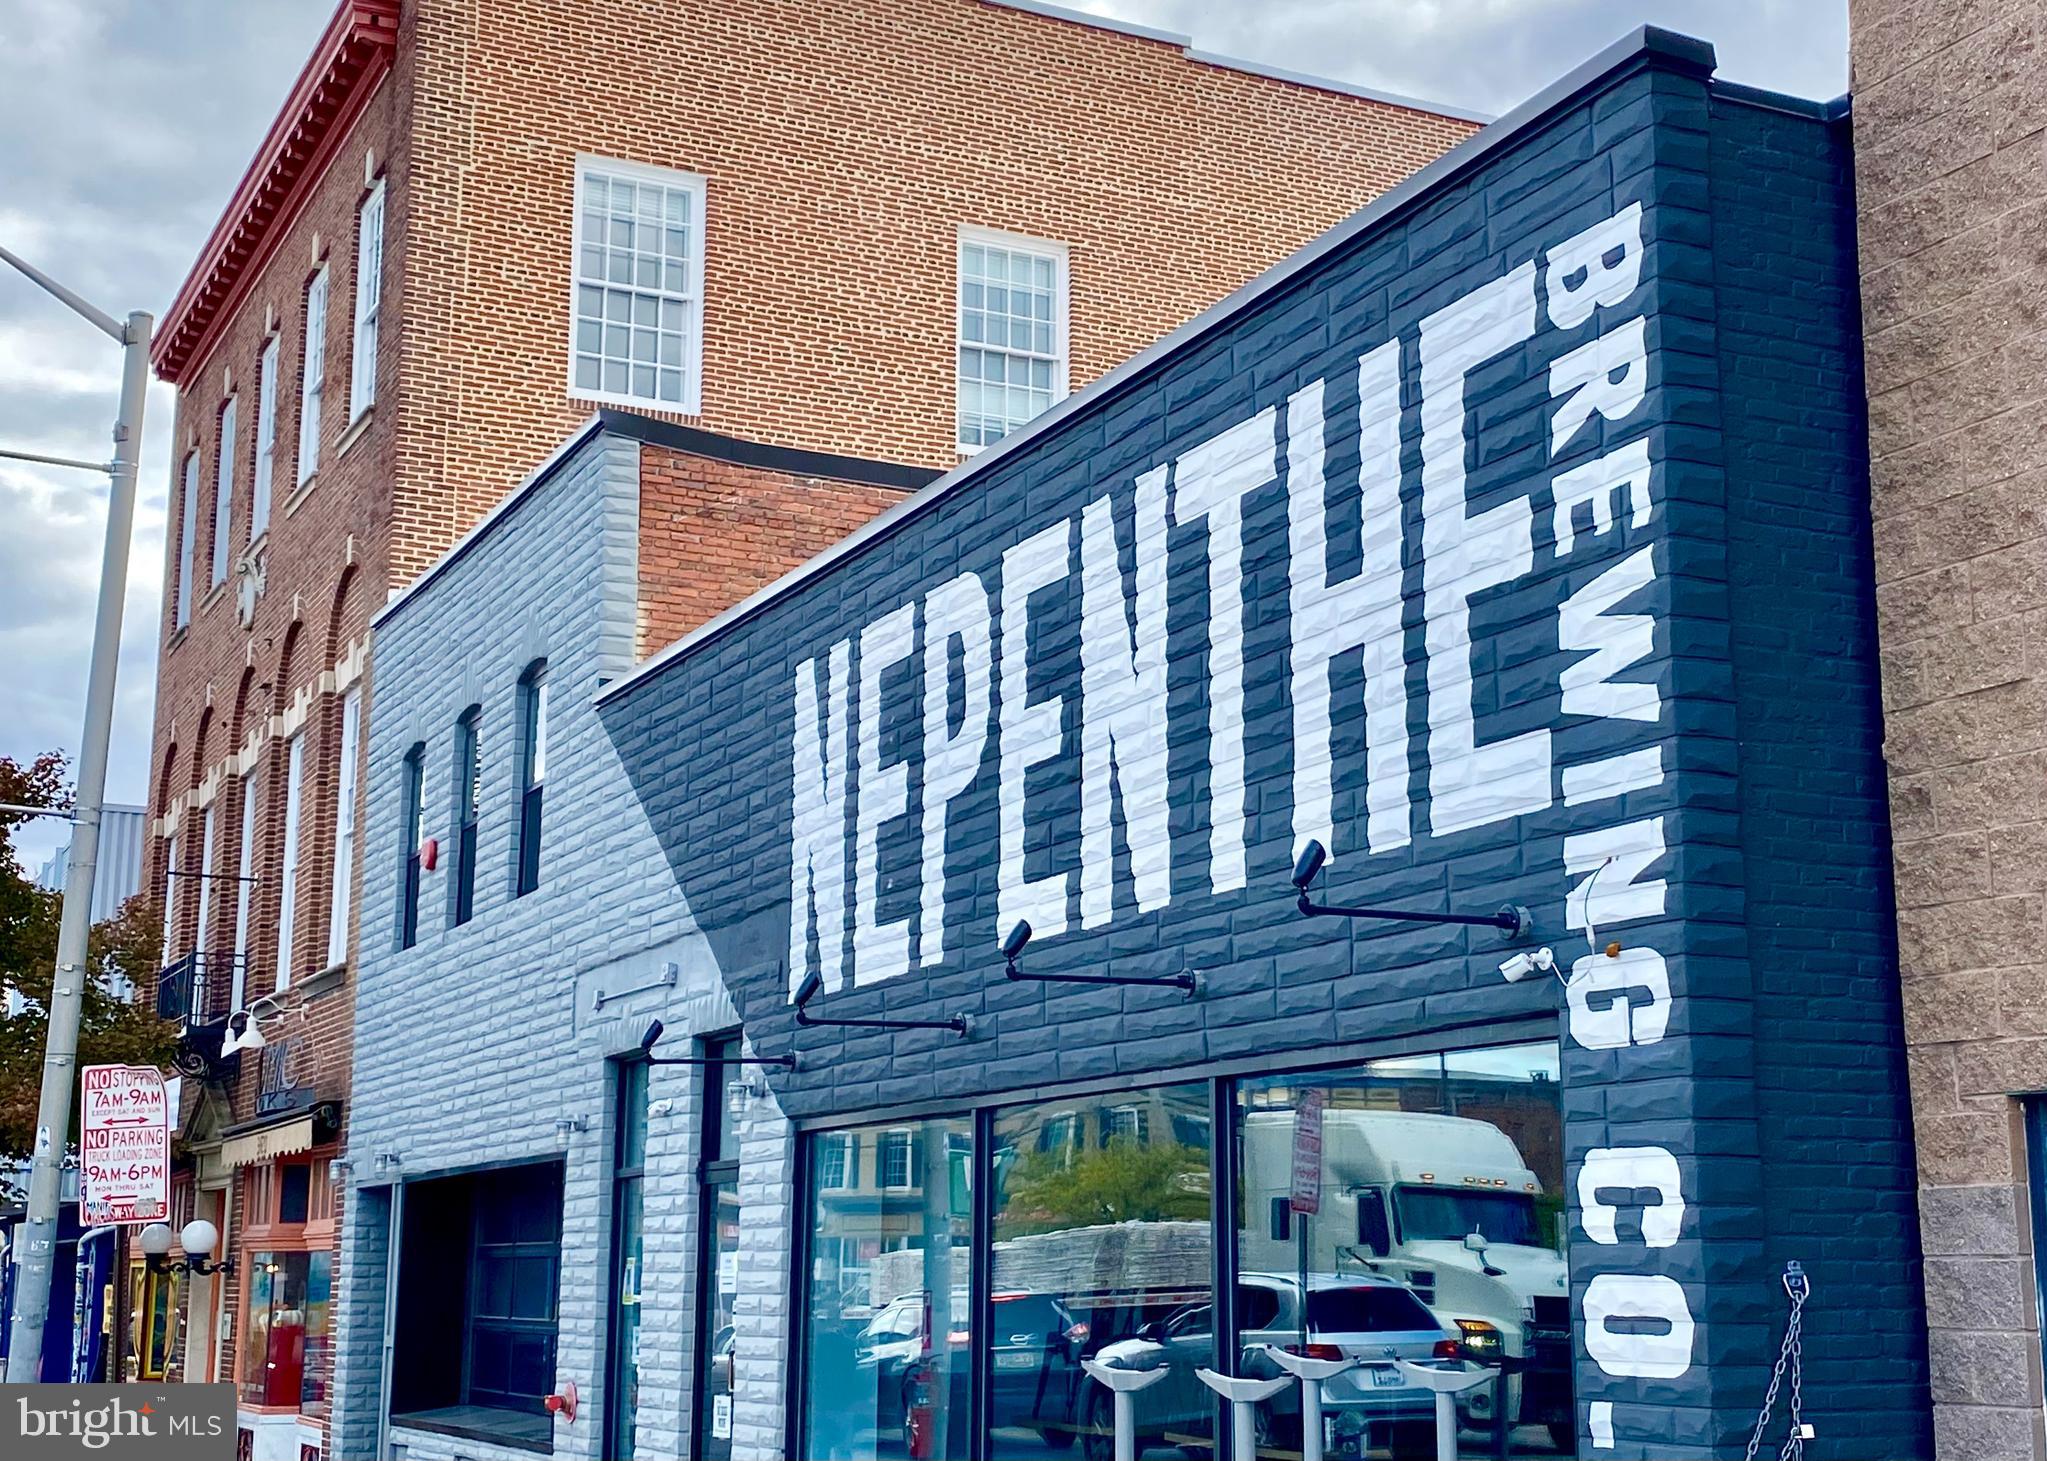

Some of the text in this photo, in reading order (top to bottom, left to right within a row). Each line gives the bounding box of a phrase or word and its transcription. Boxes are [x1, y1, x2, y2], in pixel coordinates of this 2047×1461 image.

[788, 259, 1553, 1004] NEPENTHE
[1544, 200, 1695, 1448] BREWING CO.
[88, 1071, 160, 1089] NO STOPPING
[93, 1089, 161, 1108] 7AM-9AM
[86, 1129, 163, 1148] NO PARKING
[88, 1147, 163, 1163] TRUCK LOADING ZONE
[88, 1163, 163, 1183] 9AM-6PM
[95, 1185, 112, 1193] MON
